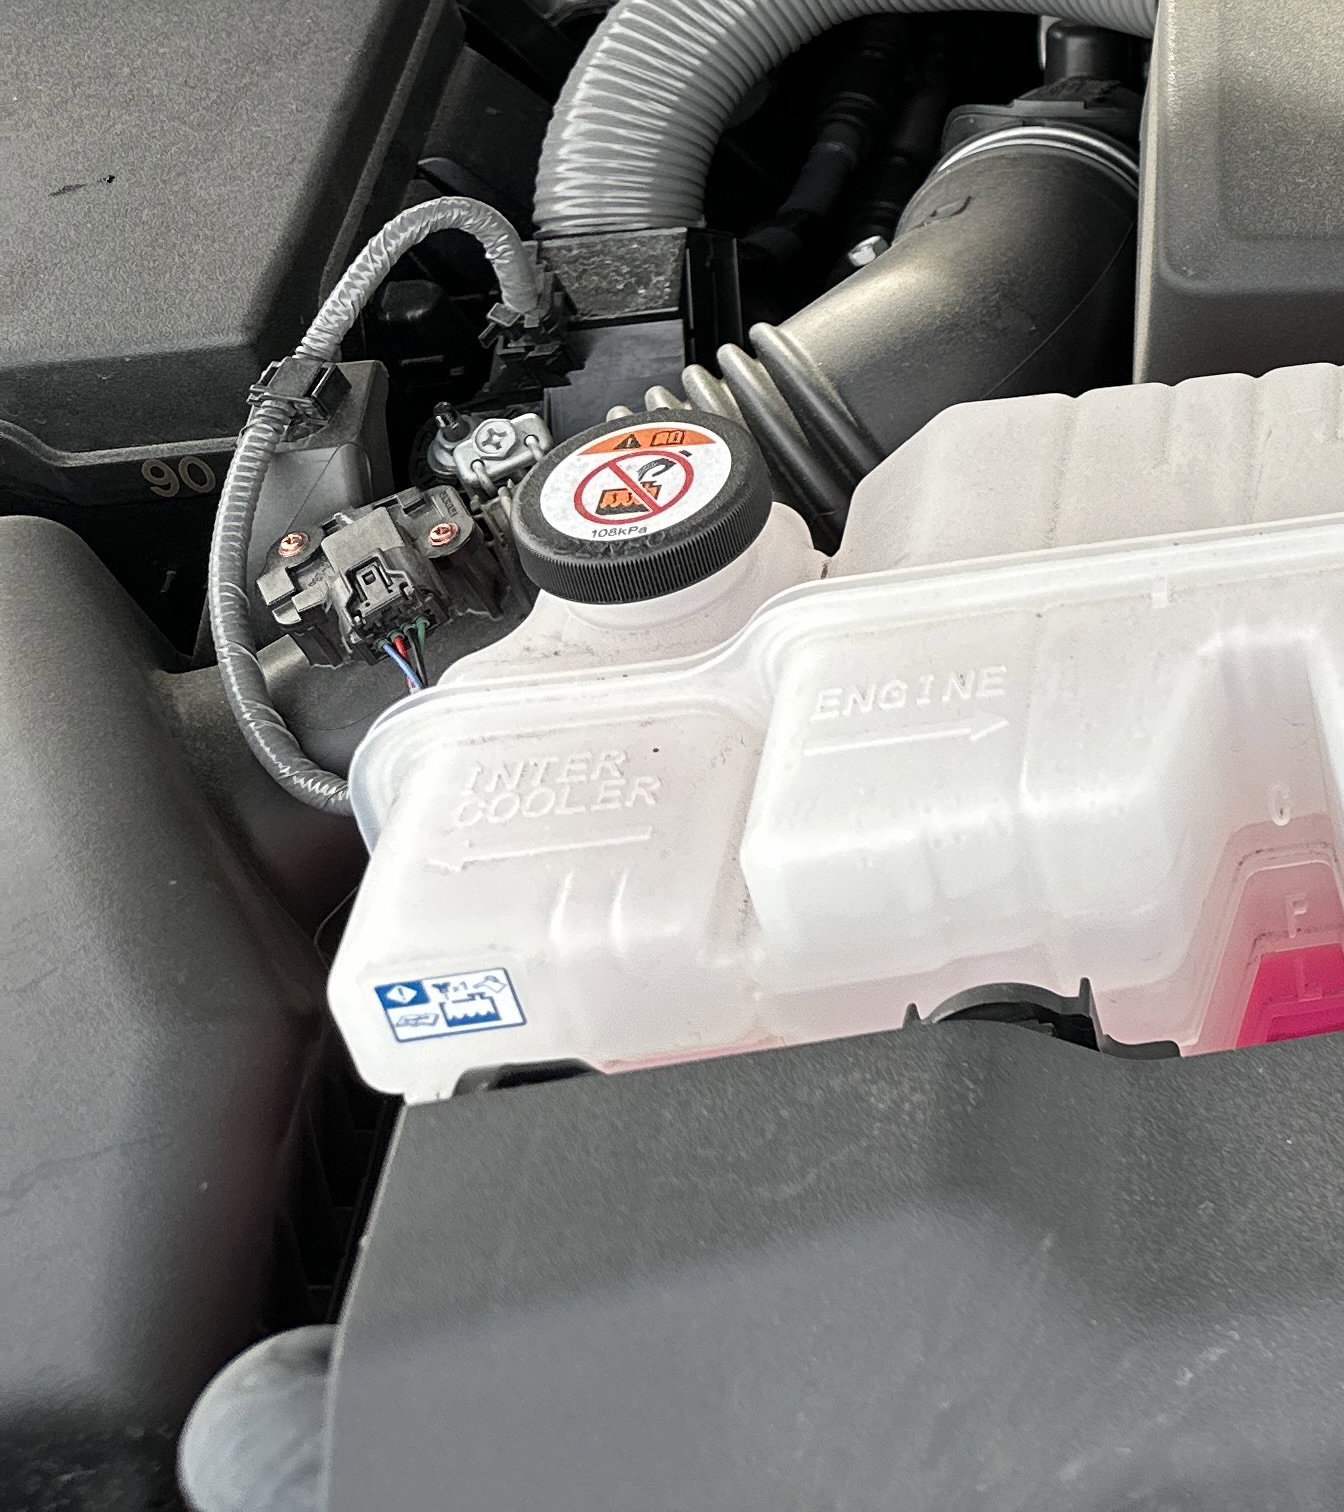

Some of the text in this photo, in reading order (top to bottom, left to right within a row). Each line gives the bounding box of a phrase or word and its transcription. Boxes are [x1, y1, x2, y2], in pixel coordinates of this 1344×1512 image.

[141, 455, 217, 498] 90
[591, 525, 648, 539] 108kPa
[810, 665, 1007, 723] ENGINE
[460, 749, 630, 797] INTER
[453, 775, 661, 828] COOLER
